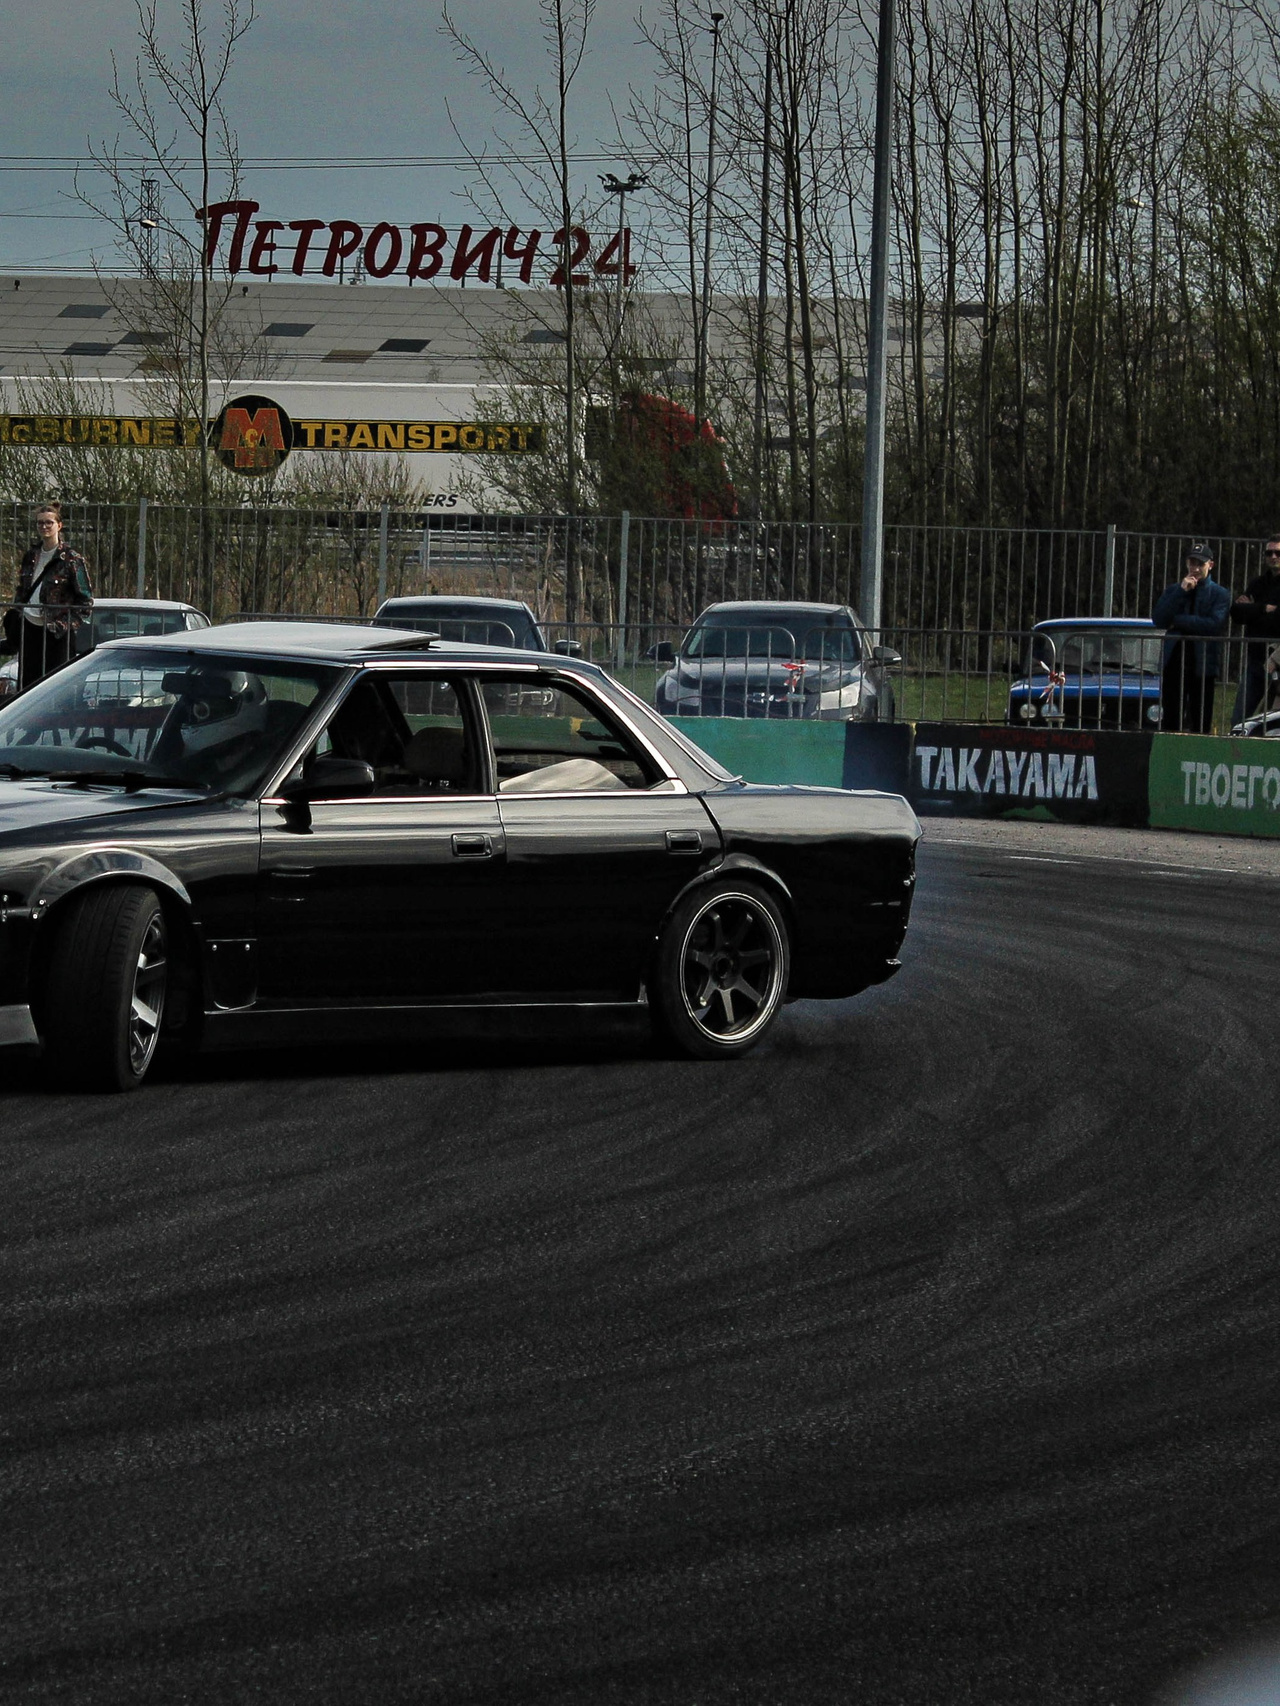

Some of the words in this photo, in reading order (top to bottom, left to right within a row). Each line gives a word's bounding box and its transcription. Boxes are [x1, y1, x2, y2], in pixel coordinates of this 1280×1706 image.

[196, 200, 542, 284] ПЕТРОВИЧ
[550, 226, 637, 288] 24
[300, 421, 534, 451] TRANSPORT
[915, 745, 1099, 801] TAKAYAMA
[1180, 760, 1280, 811] ТВОЕГО
